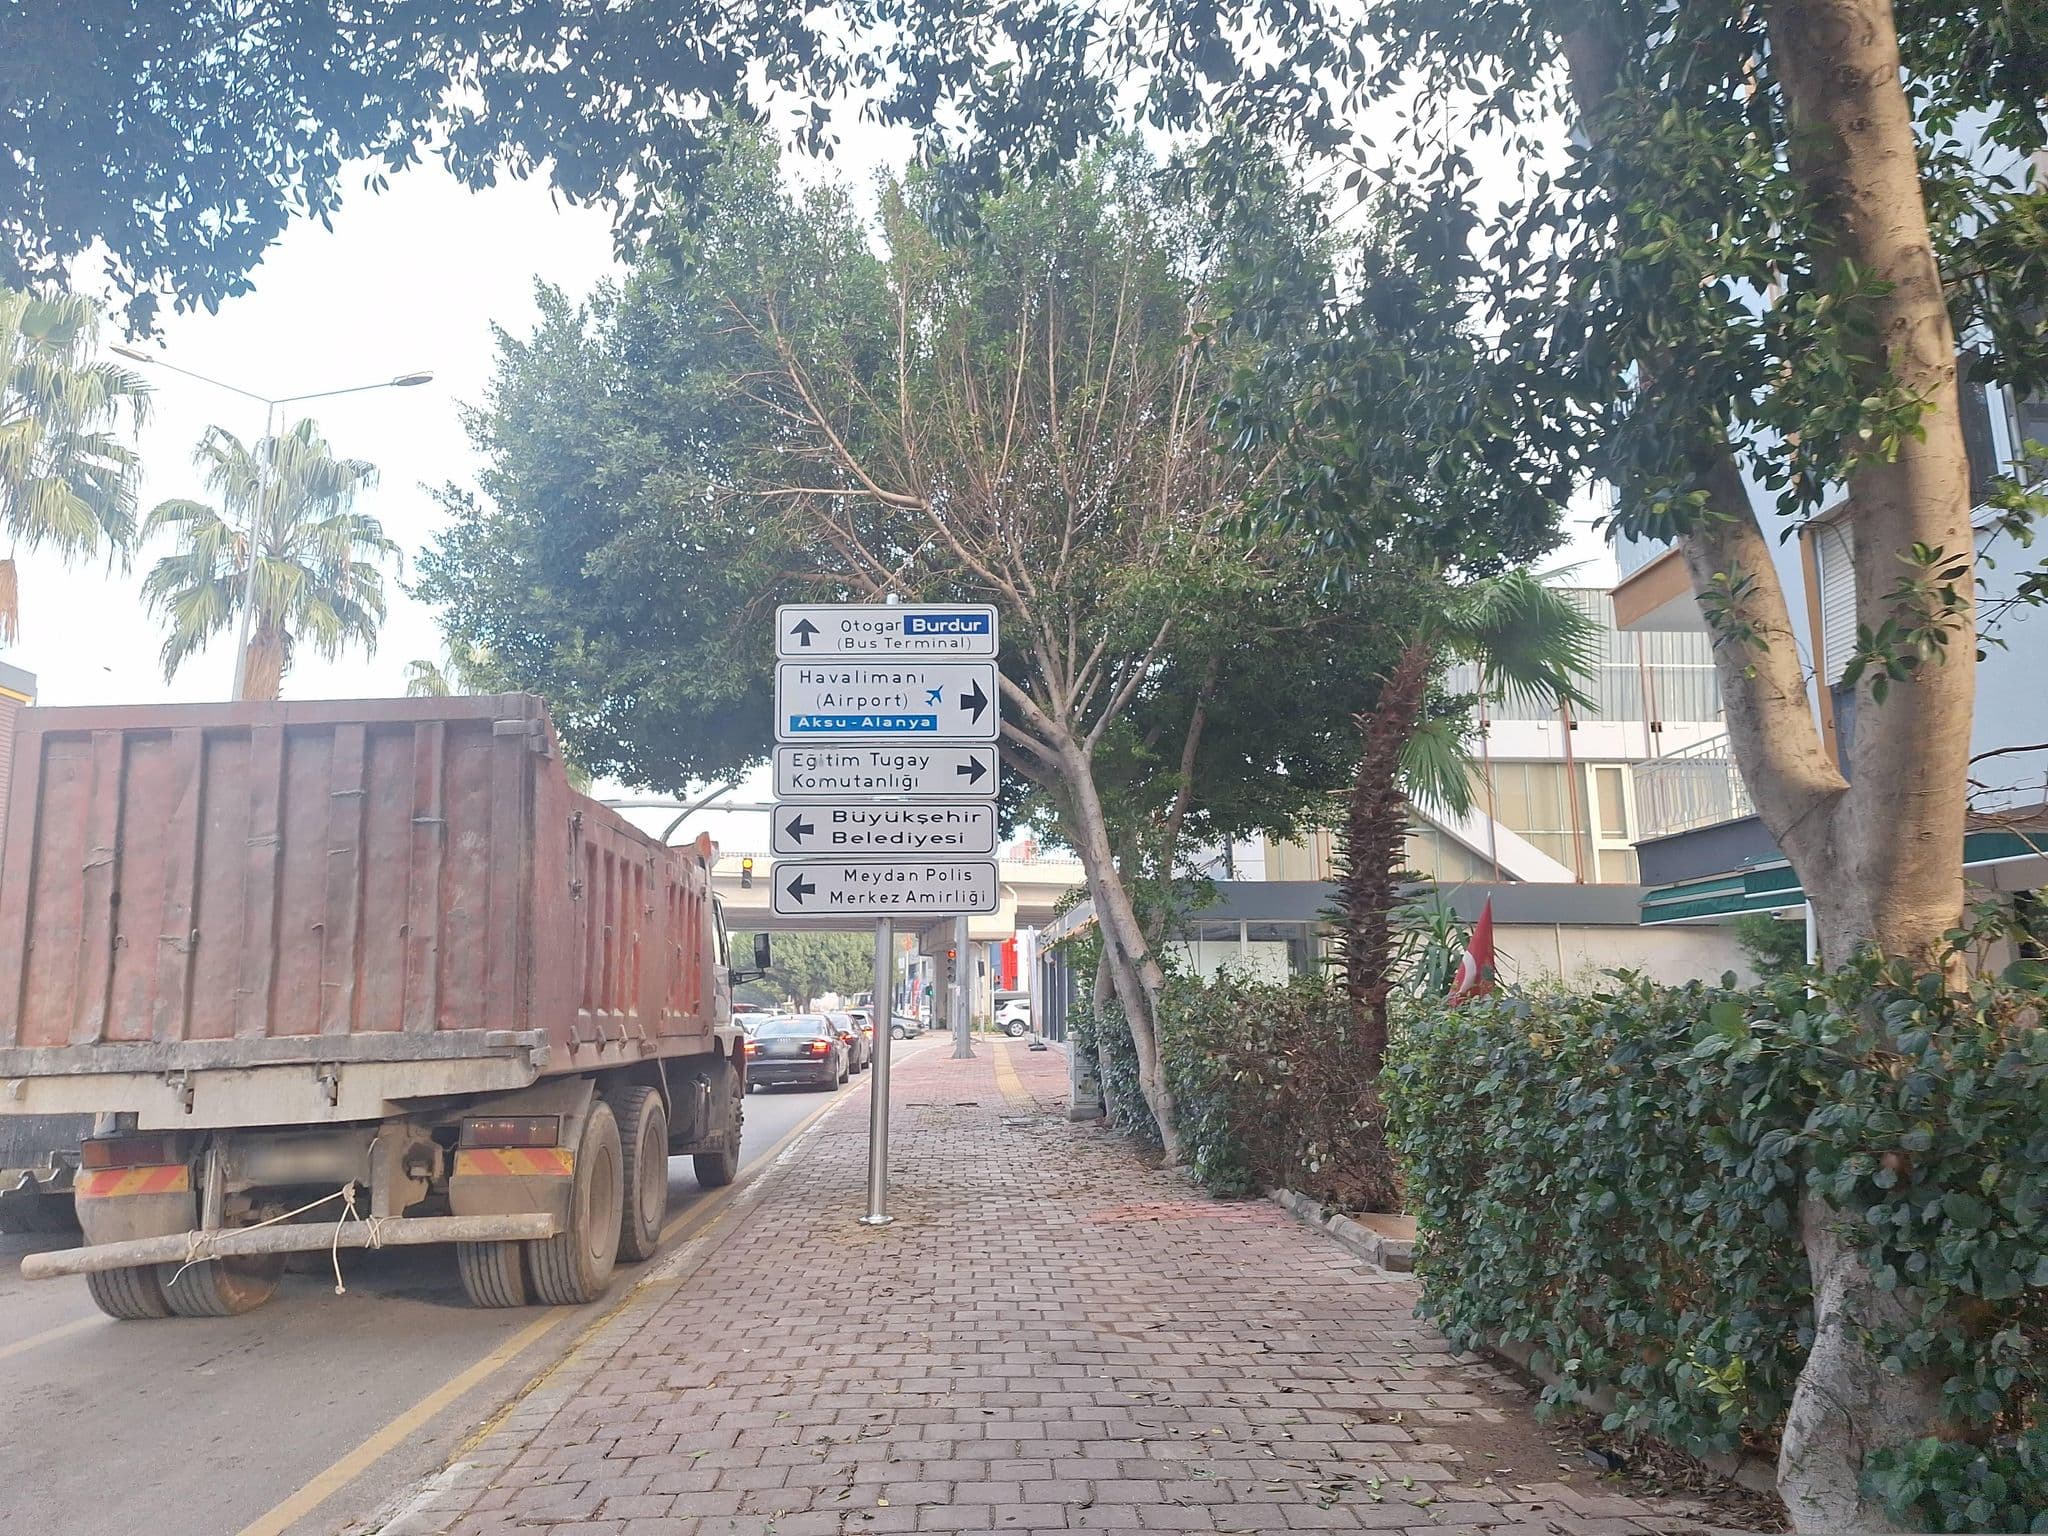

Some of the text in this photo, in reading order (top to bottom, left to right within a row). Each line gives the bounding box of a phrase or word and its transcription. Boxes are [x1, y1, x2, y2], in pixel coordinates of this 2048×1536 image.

[841, 620, 902, 634] Otogar
[912, 618, 982, 633] Burdur
[837, 637, 972, 651] (Bus Terminal)
[800, 670, 925, 684] Havalimanı
[816, 693, 909, 710] (Airport)
[870, 752, 930, 769] Tugay
[792, 774, 919, 791] Komutanlığı
[832, 810, 982, 827] Büyükşehir
[832, 831, 964, 848] Belediyesi
[844, 868, 972, 885] Meydan Polis
[830, 889, 985, 906] Merkez Amirliği
